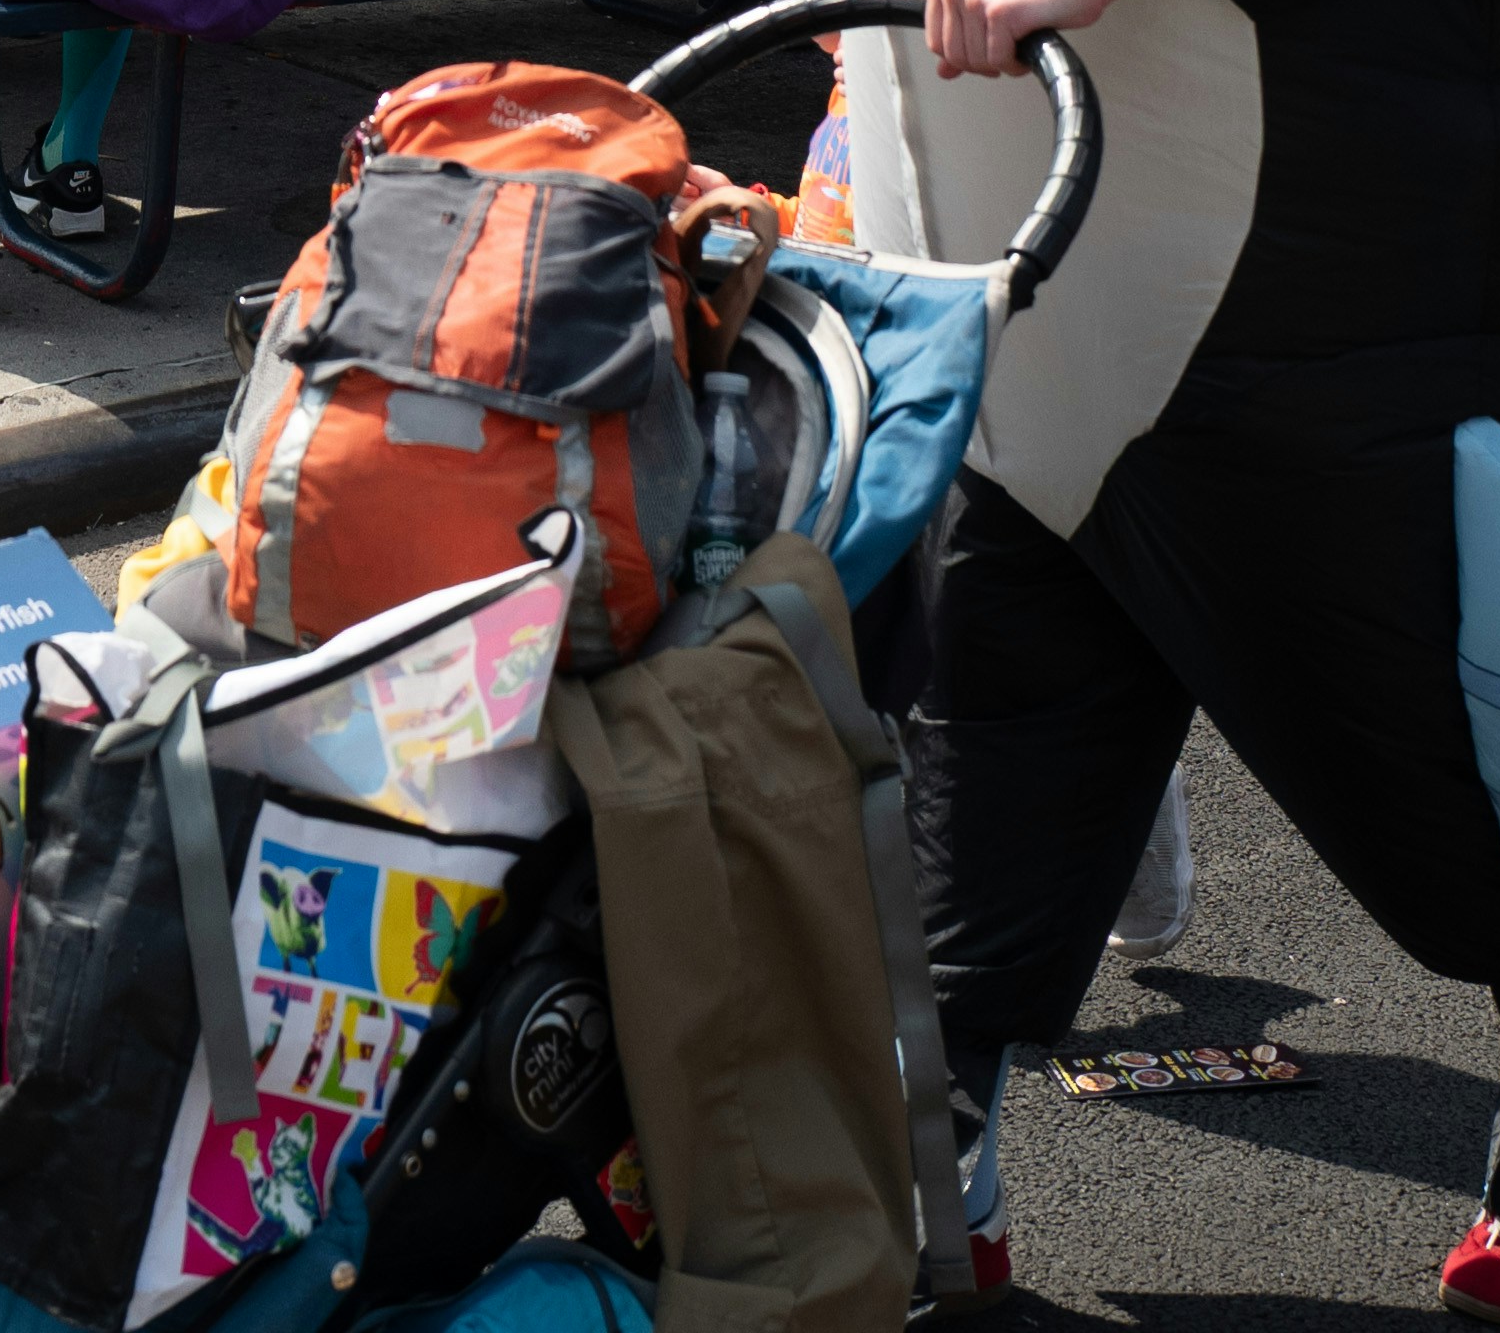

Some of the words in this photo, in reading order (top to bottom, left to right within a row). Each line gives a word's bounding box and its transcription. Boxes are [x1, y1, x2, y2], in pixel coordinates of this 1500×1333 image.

[692, 544, 747, 569] Poland
[523, 1032, 558, 1080] city
[527, 1039, 576, 1110] mini
